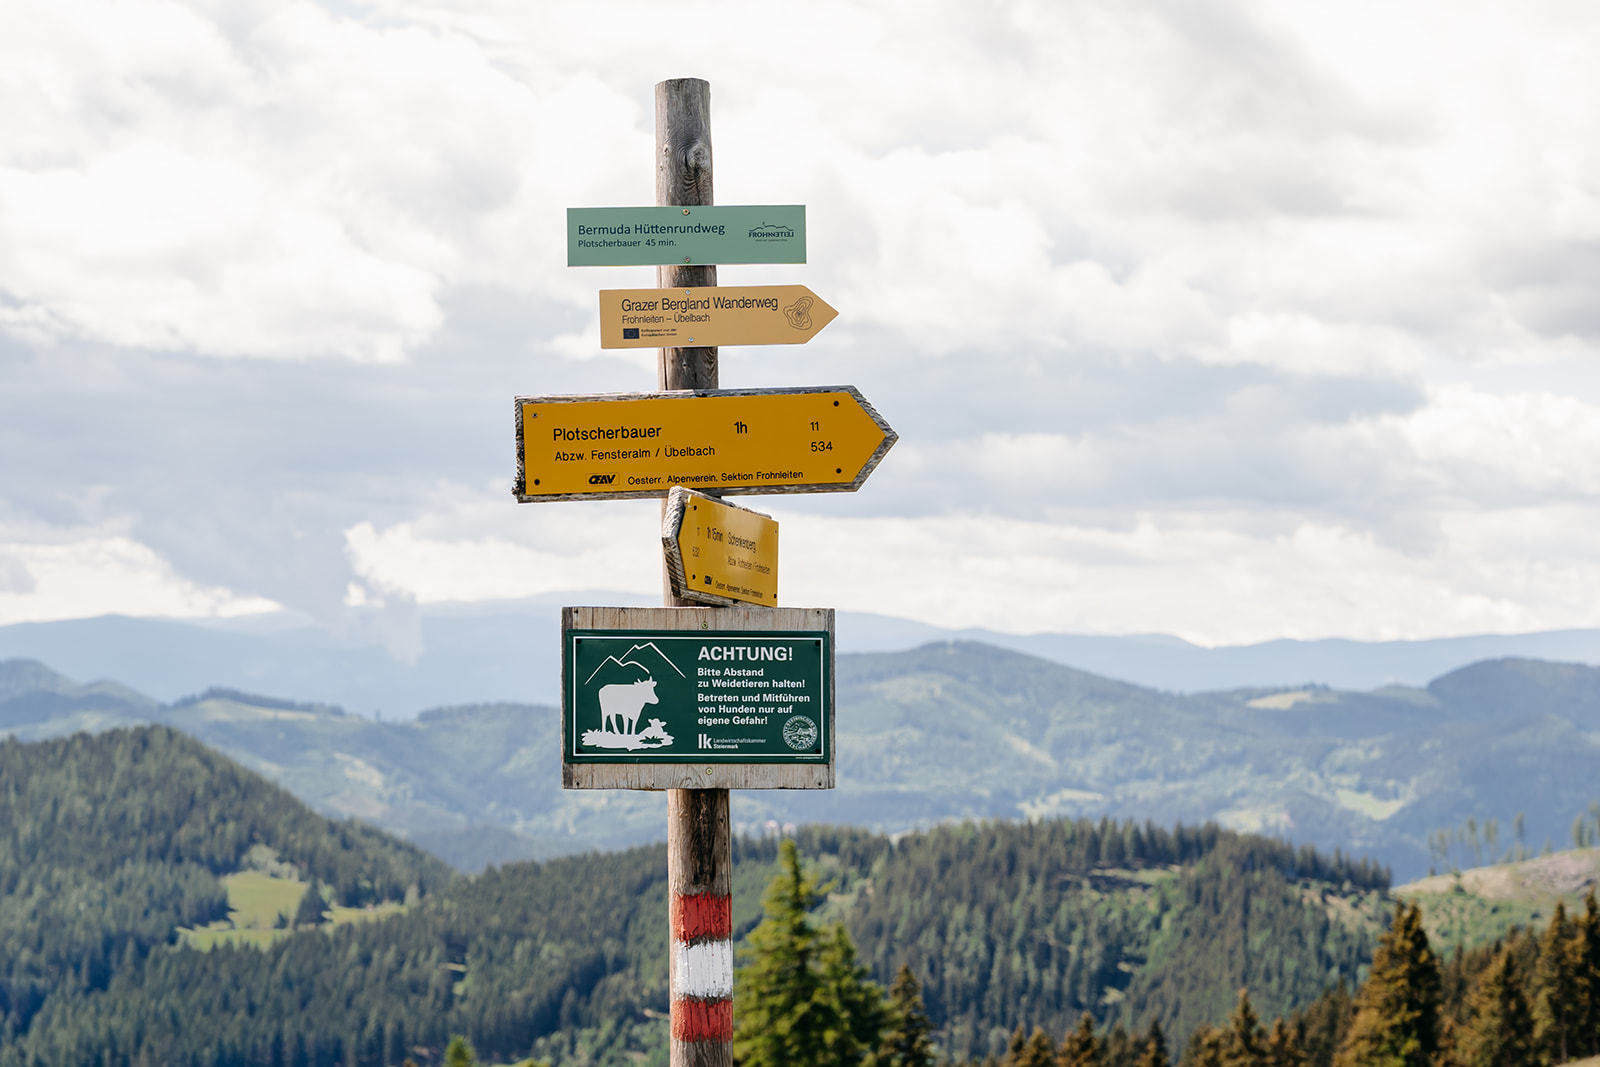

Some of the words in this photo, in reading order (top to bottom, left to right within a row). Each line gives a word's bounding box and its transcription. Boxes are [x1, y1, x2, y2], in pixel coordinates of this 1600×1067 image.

[578, 224, 631, 235] Bermuda
[634, 223, 725, 235] Hüttenrundweg
[578, 239, 641, 248] Plotscherbauer
[645, 239, 656, 247] 45
[658, 238, 677, 247] min.
[621, 298, 659, 312] Grazer
[661, 297, 710, 313] Bergland
[713, 296, 778, 311] Wanderweg
[622, 314, 664, 324] Frohnleiten
[674, 312, 710, 323] Übelbach
[733, 421, 748, 434] 1h
[810, 421, 820, 431] 11
[553, 426, 662, 441] Plotscherbauer
[810, 441, 833, 452] 534
[554, 450, 587, 461] Abzw.
[591, 448, 651, 460] Fensteralm
[664, 445, 716, 458] Übelbach
[628, 475, 664, 485] Oesterr.
[721, 472, 754, 482] Sektion
[756, 470, 804, 480] Frohnleiten
[698, 646, 793, 661] ACHTUNG!
[697, 667, 721, 676] Bitte
[723, 667, 764, 676] Abstand
[711, 679, 770, 688] Weidetieren
[772, 679, 805, 688] halten!
[697, 693, 739, 702] Betreten
[741, 693, 760, 702] und
[762, 693, 810, 702] Mitführen
[718, 705, 756, 714] Hunden
[777, 705, 793, 713] auf
[697, 717, 730, 726] eigene
[732, 716, 768, 725] Gefahr!
